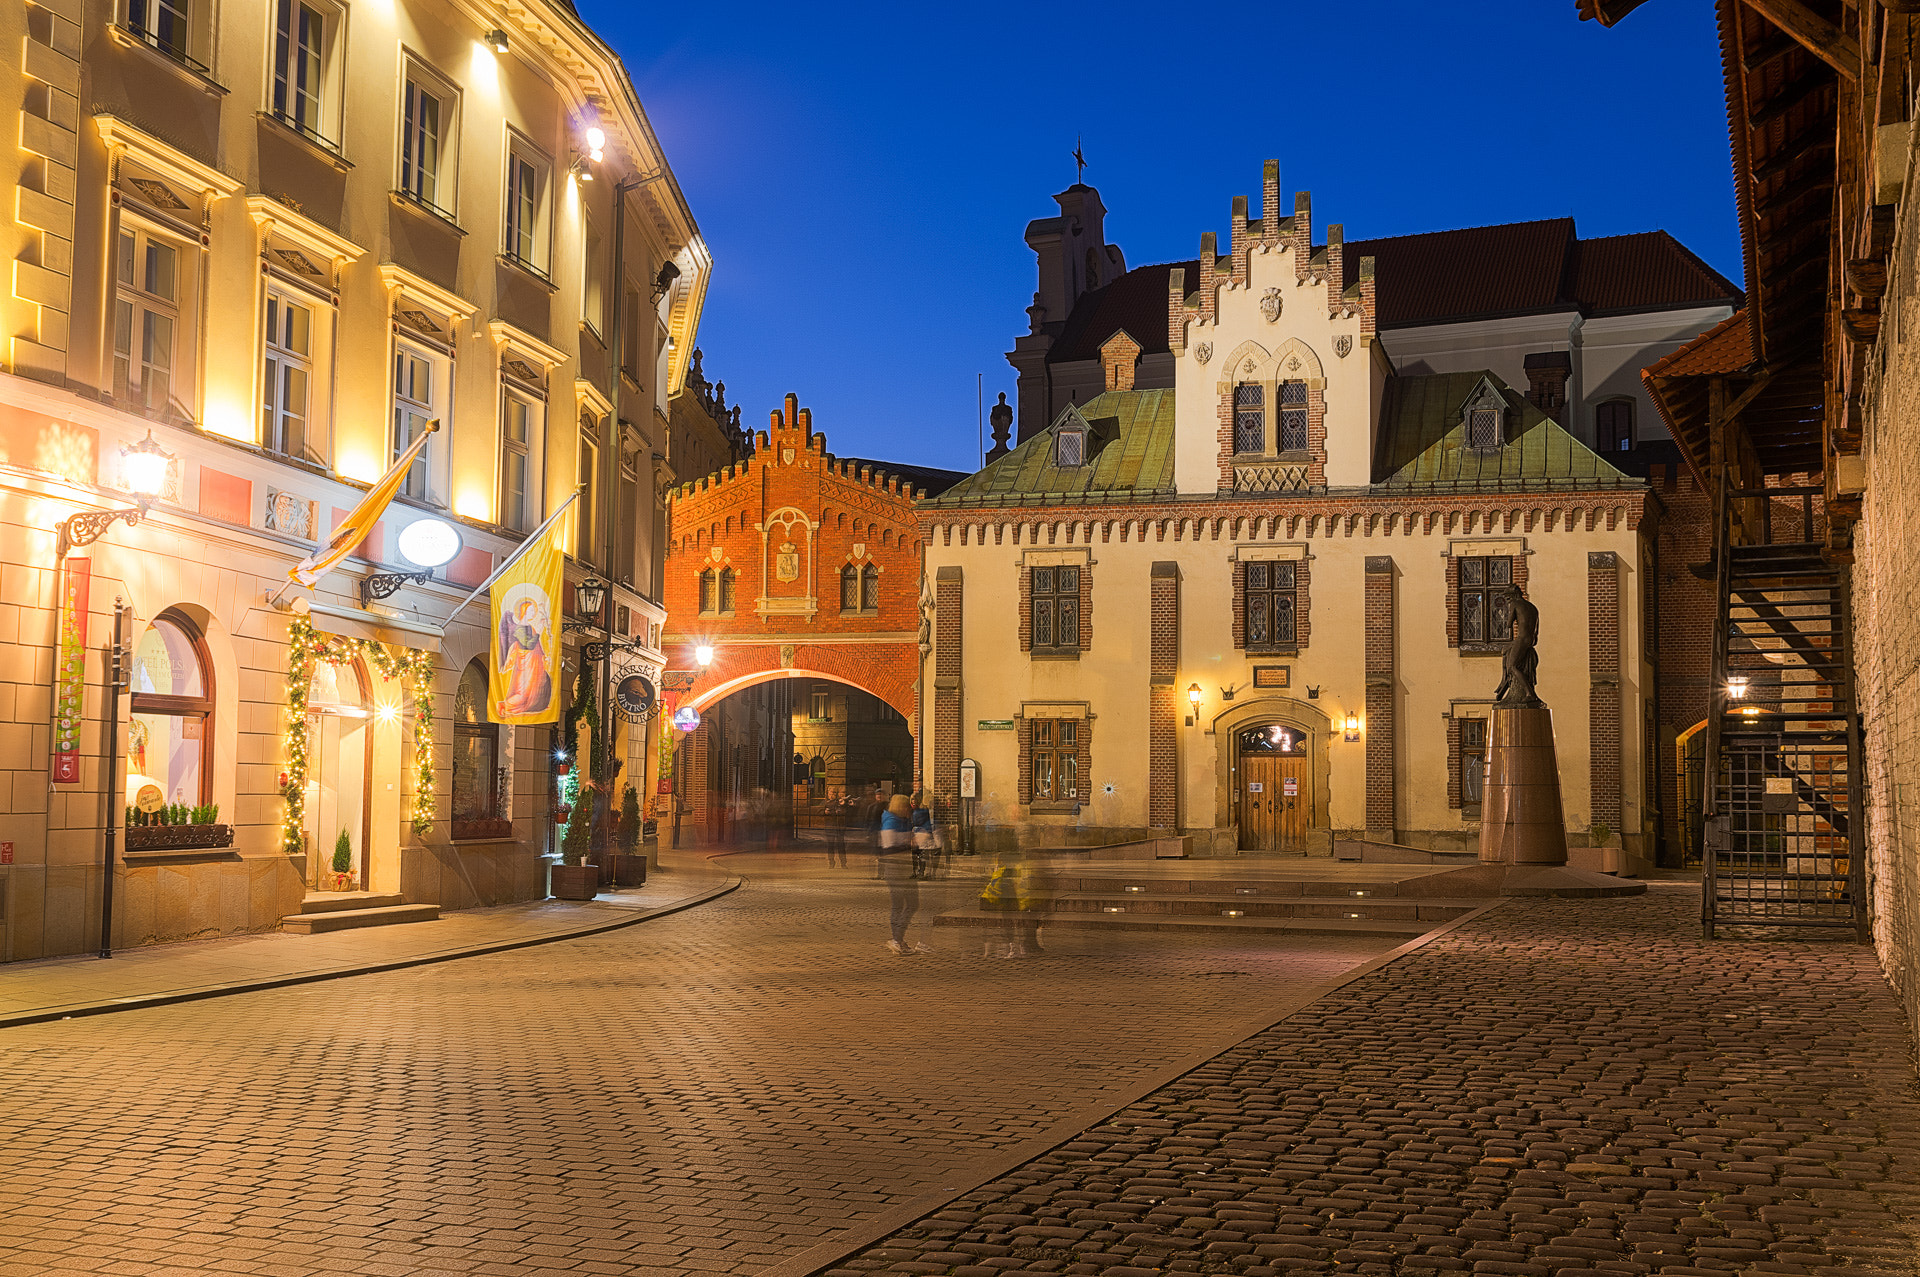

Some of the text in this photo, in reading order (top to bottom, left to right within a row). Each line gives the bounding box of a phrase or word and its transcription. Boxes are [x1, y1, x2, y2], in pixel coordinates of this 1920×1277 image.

[610, 664, 657, 685] PIJARSKA
[608, 698, 665, 723] RESTAURACJA
[617, 693, 647, 712] BISTRO
